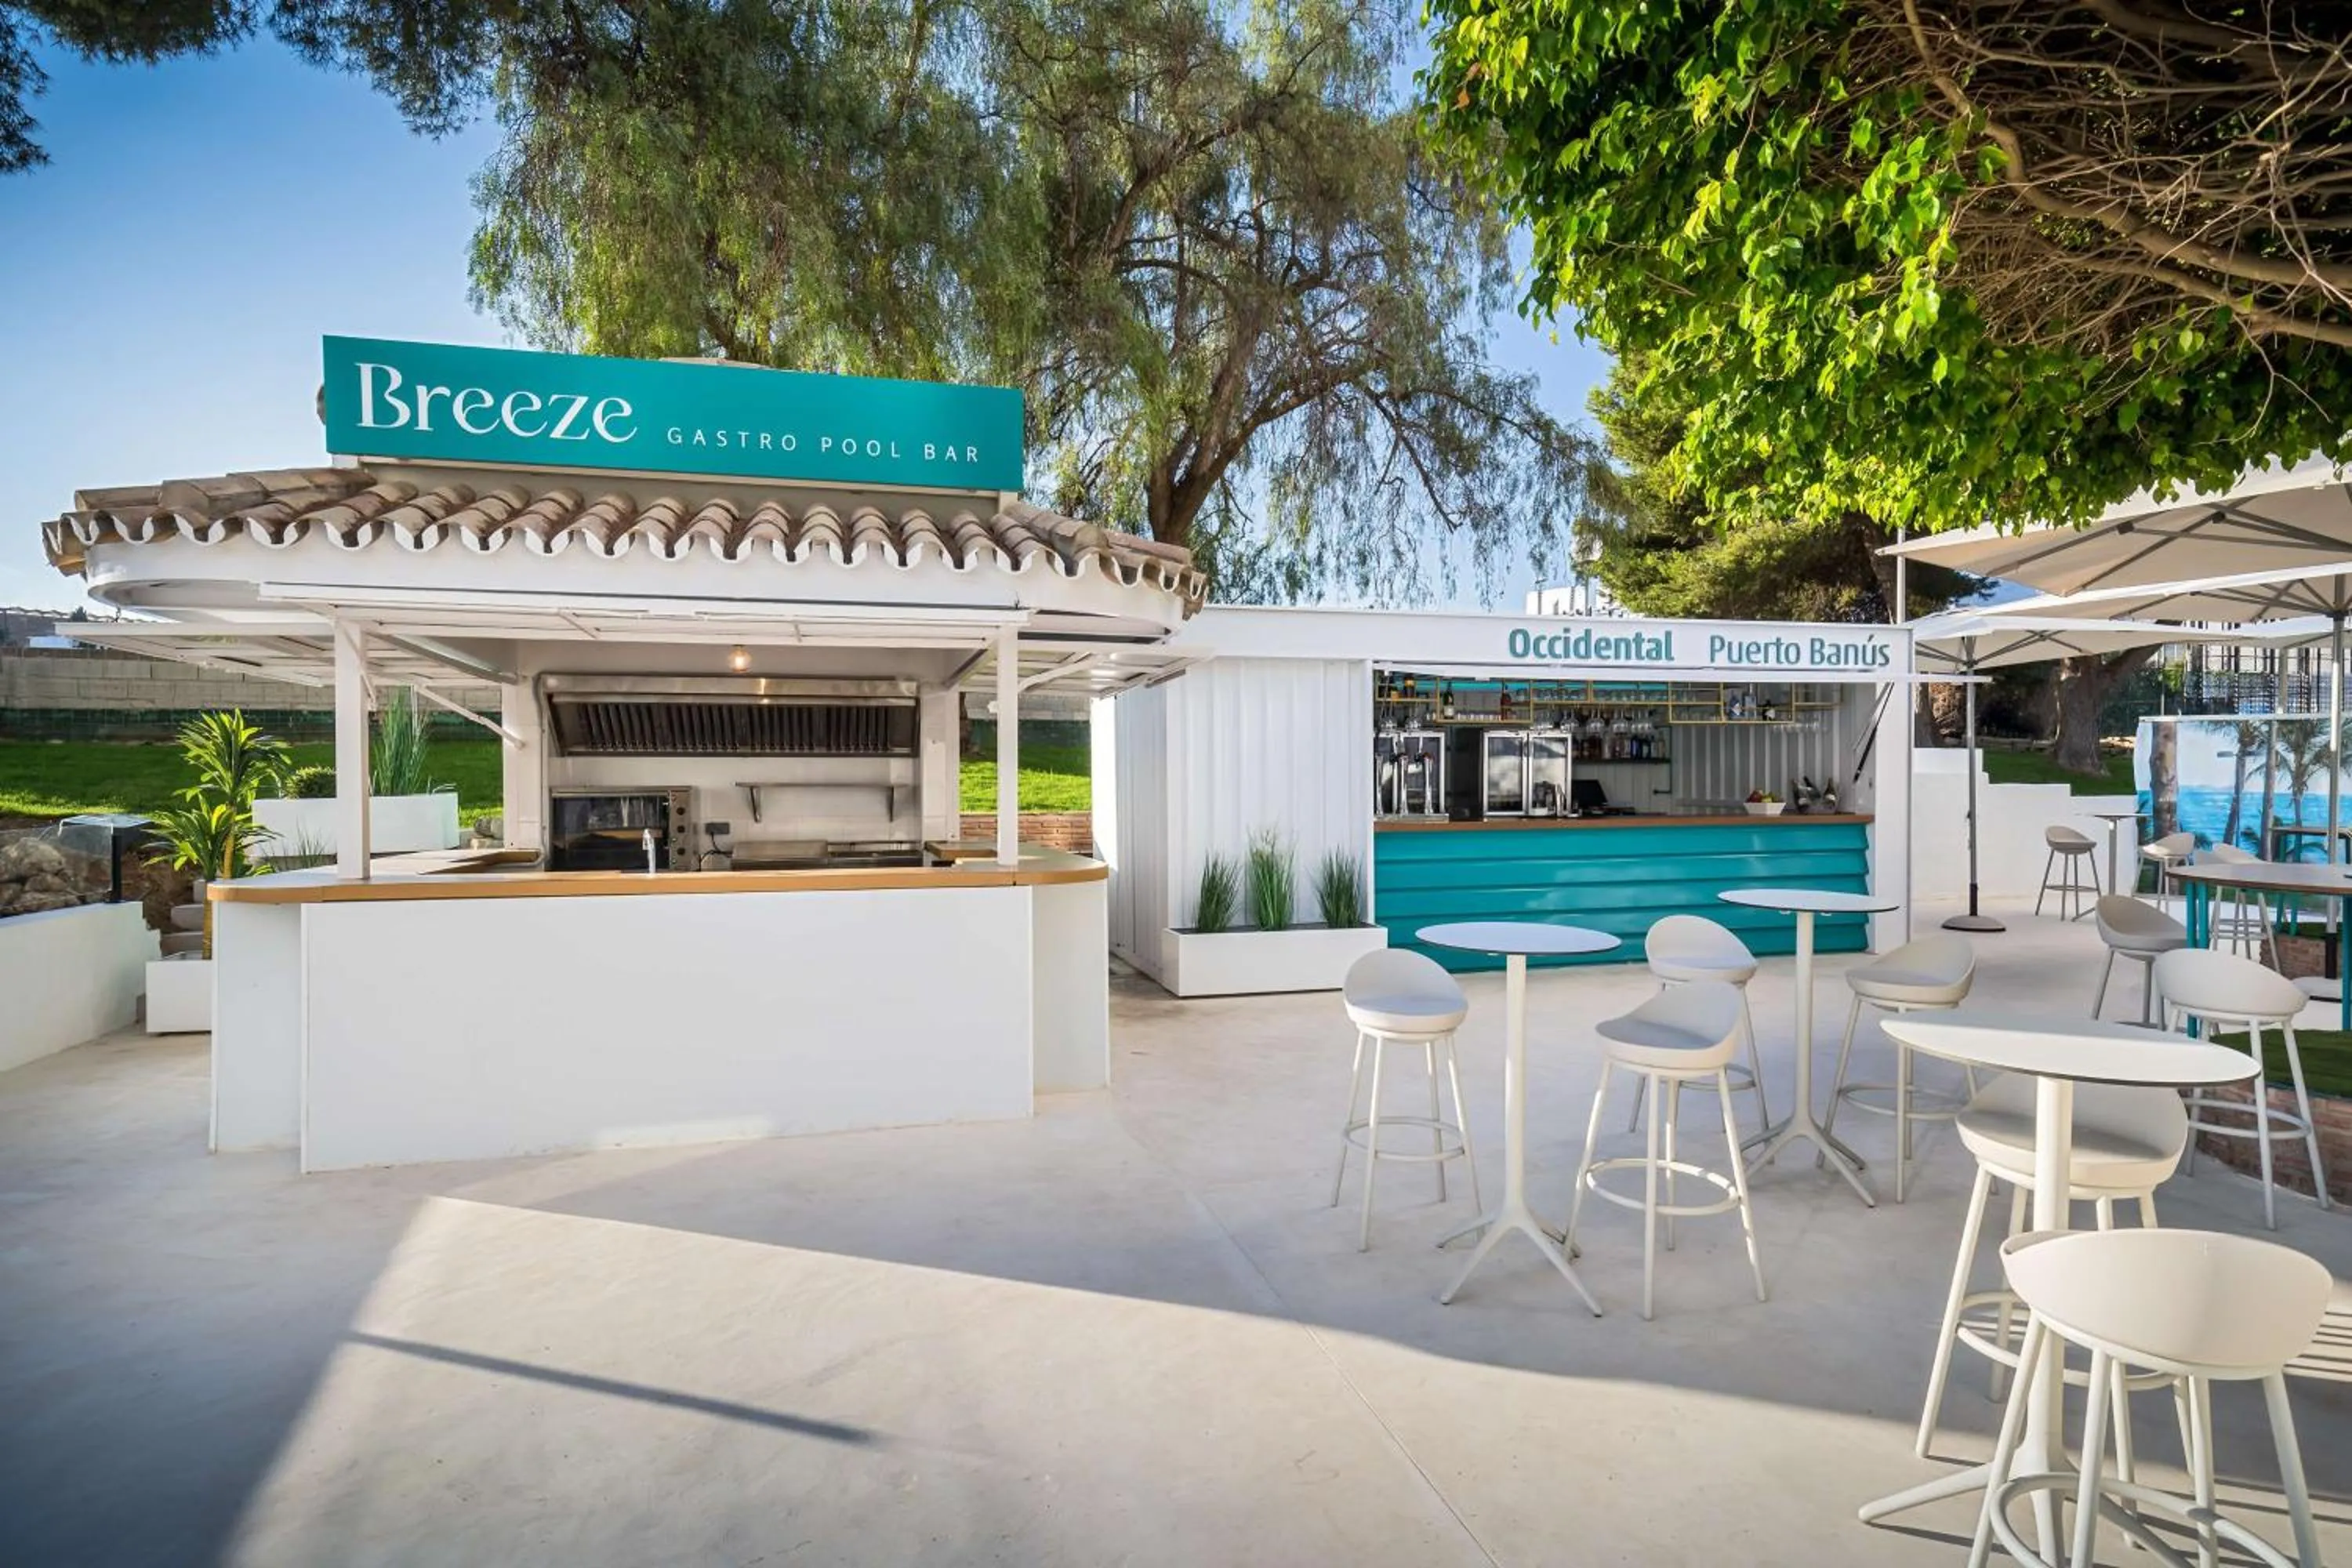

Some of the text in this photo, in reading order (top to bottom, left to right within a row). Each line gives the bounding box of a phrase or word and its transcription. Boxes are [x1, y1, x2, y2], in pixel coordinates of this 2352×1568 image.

[355, 362, 637, 443] Breeze
[666, 427, 979, 463] GASTRO POOL BAR
[1508, 628, 1890, 666] Occidental Puerto Banús
